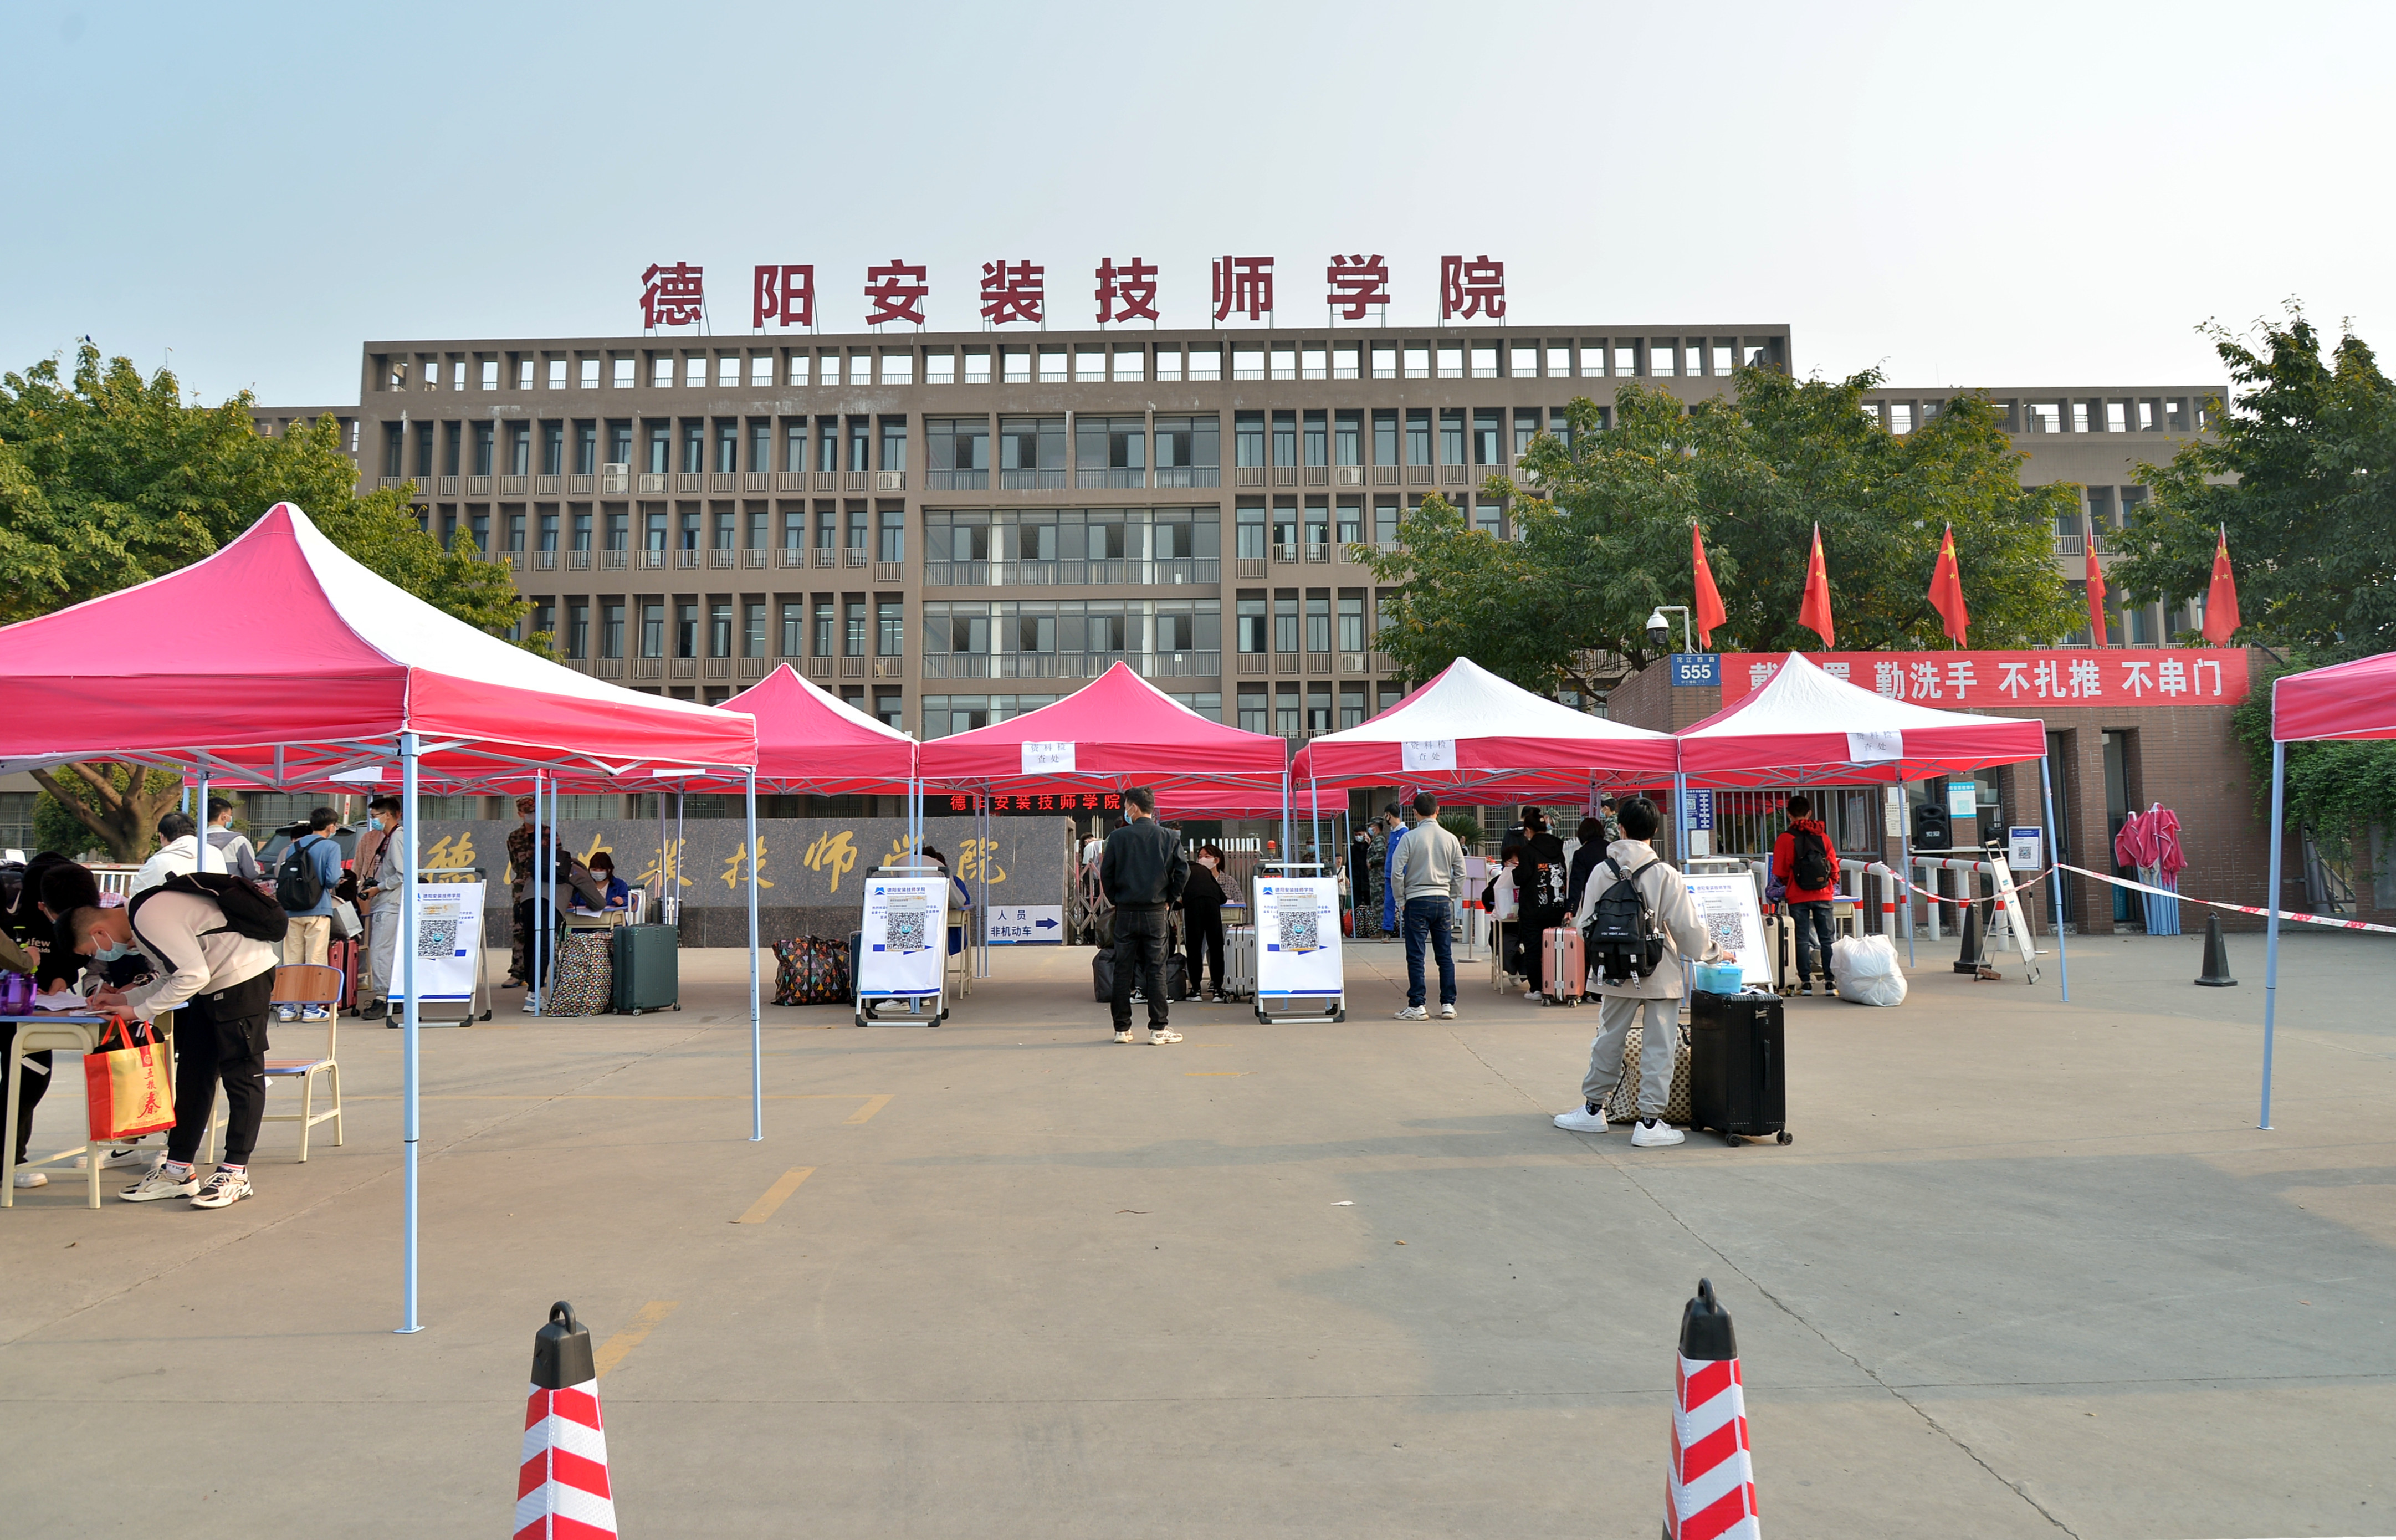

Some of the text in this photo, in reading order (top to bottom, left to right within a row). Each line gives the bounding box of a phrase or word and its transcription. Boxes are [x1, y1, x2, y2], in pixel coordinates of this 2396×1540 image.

[639, 254, 1506, 328] 德阳安装技师学院
[1681, 664, 1712, 679] 555
[1749, 658, 2221, 699] 戴罩 勤洗手 不扎推 不串门
[1038, 754, 1059, 763] 查处
[997, 909, 1026, 920] 人员
[990, 925, 1032, 937] 非机动车
